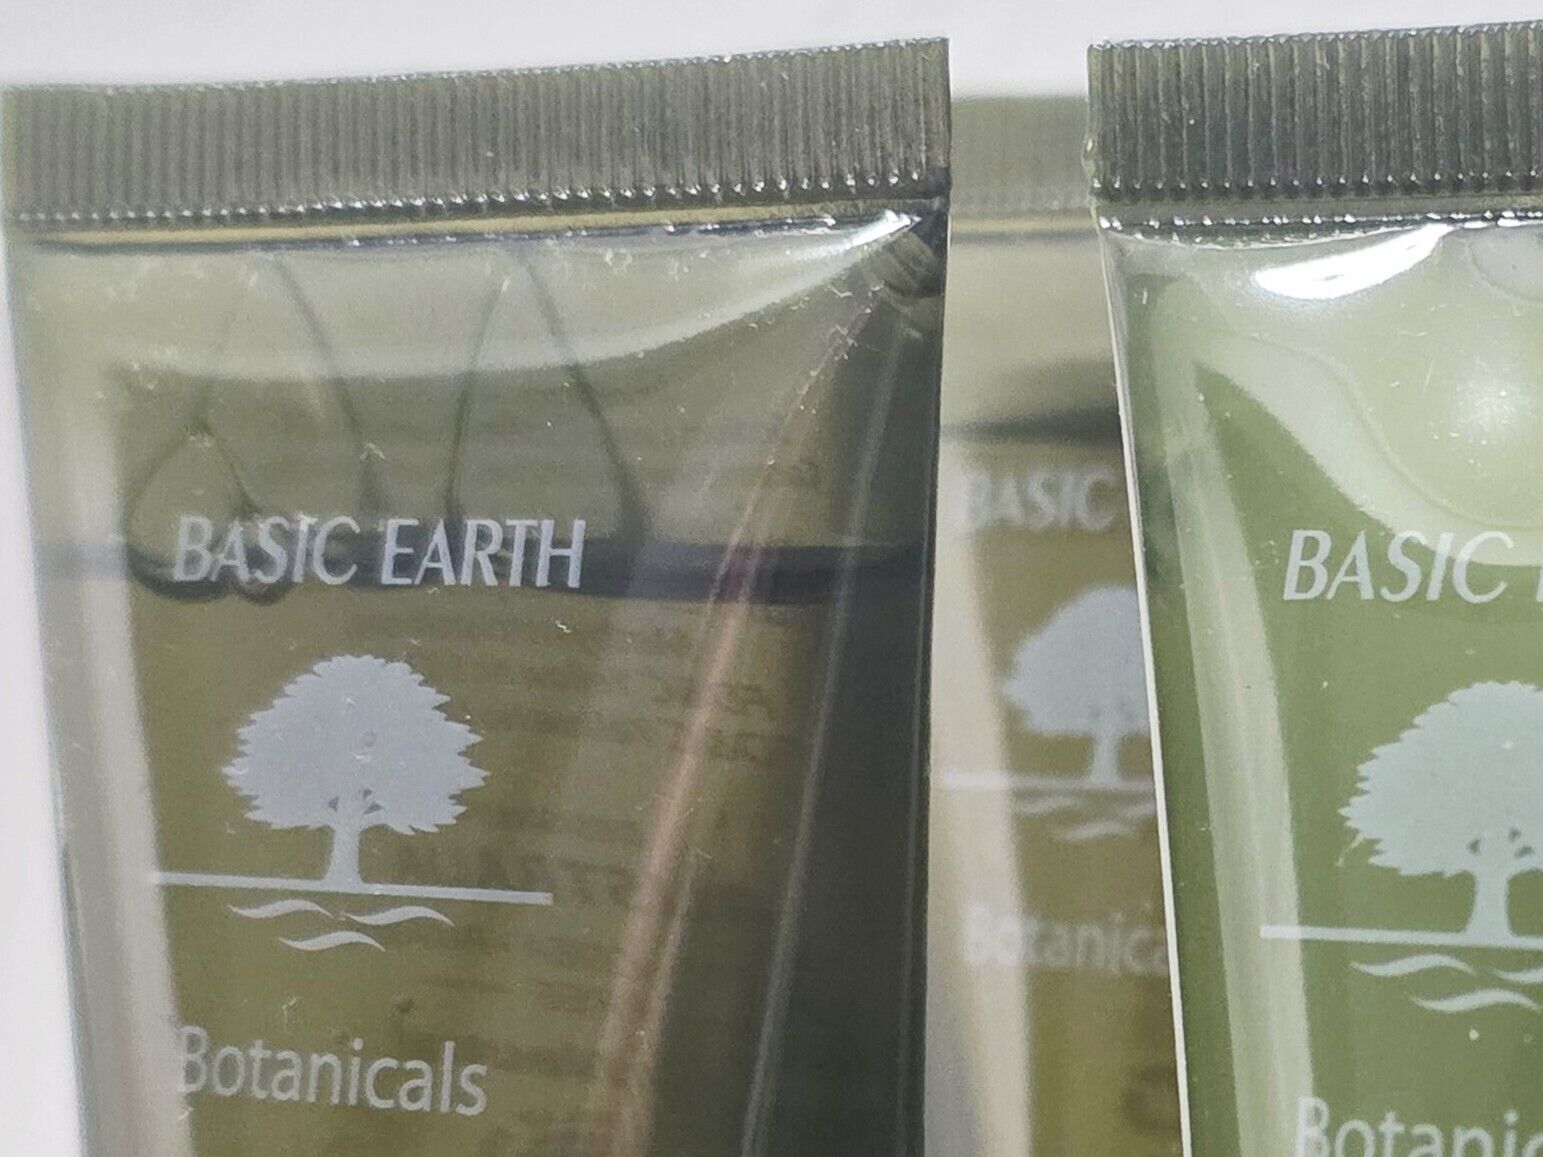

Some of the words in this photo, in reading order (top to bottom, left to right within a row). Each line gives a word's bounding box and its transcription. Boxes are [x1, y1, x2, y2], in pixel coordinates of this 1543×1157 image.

[948, 463, 1118, 531] BASIC
[172, 515, 361, 586] BASIC
[380, 517, 586, 589] EARTH
[1282, 527, 1514, 603] BASIC
[177, 1025, 488, 1117] Botanicals
